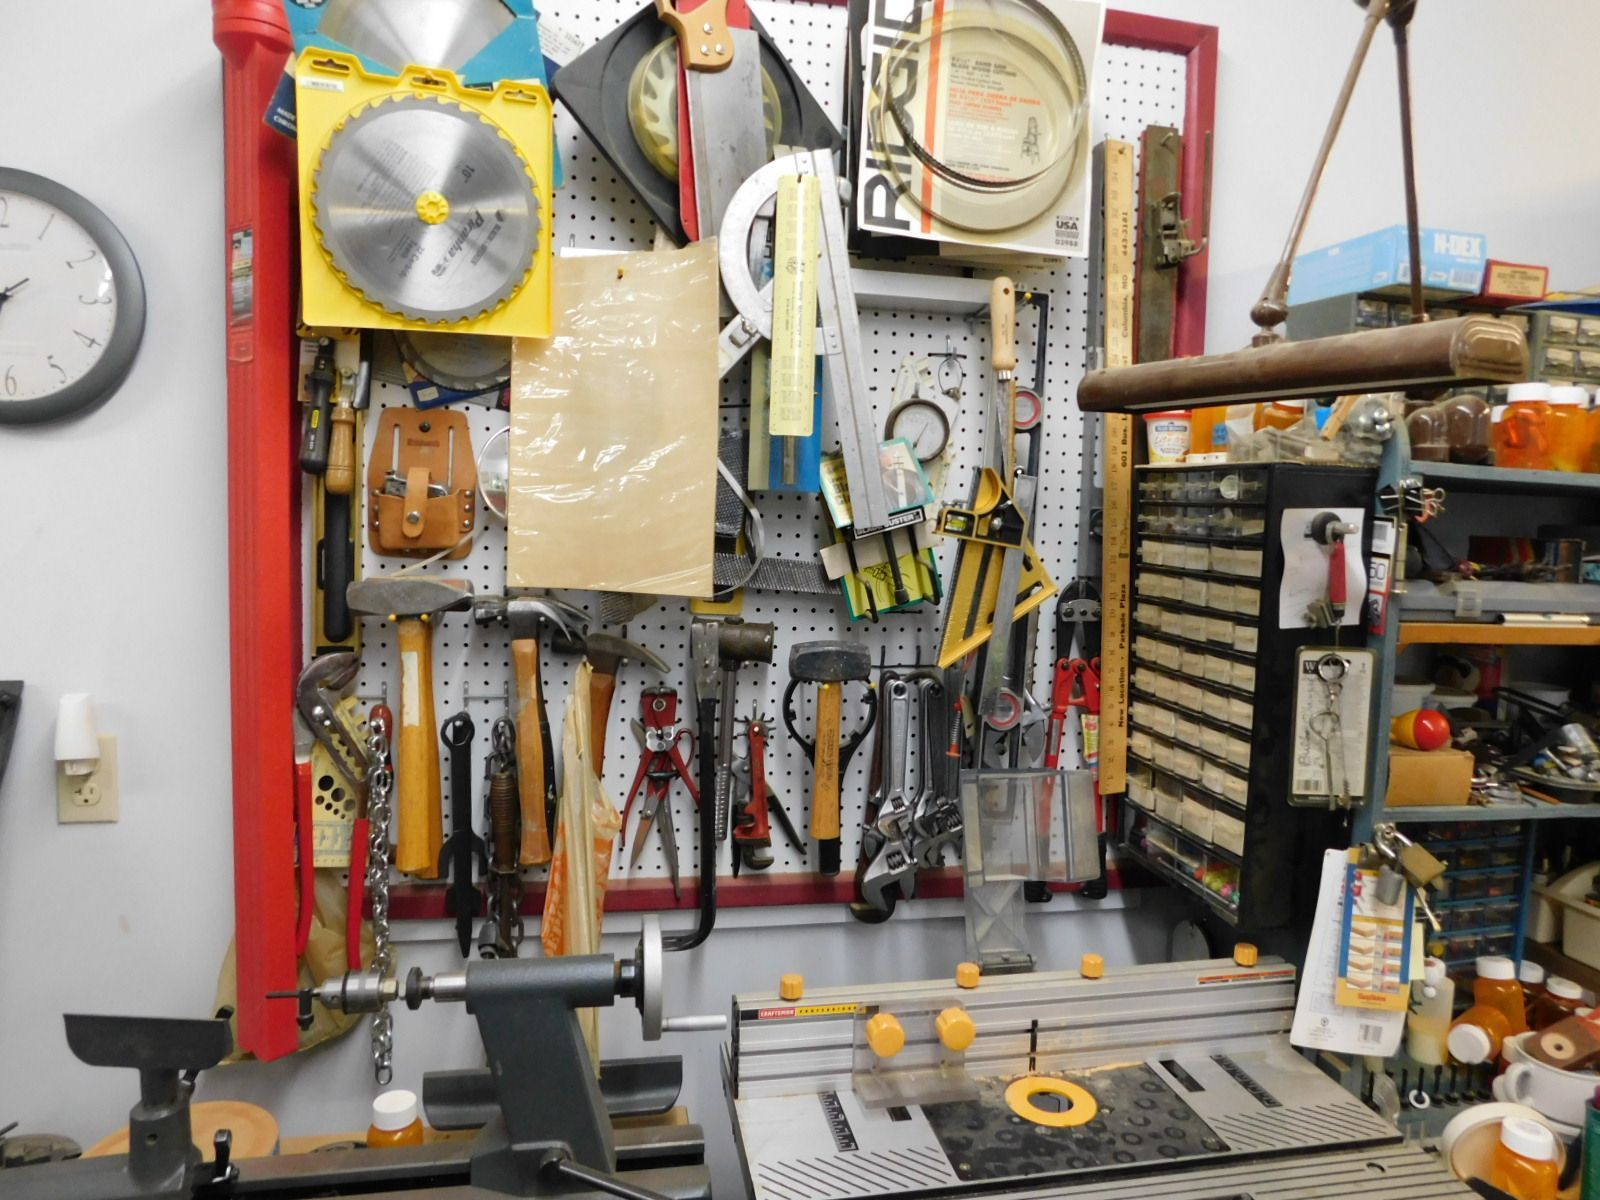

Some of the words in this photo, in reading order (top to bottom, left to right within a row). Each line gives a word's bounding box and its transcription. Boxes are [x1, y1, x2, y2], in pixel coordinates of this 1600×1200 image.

[1055, 220, 1078, 230] USA
[65, 249, 97, 270] 2
[1121, 274, 1129, 290] MO
[78, 294, 113, 306] 3
[72, 329, 103, 348] 4
[47, 354, 68, 385] 5
[4, 364, 18, 397] 6
[1118, 666, 1126, 704] Location
[1117, 709, 1125, 728] New
[760, 1009, 795, 1018] CRAFTSMAN
